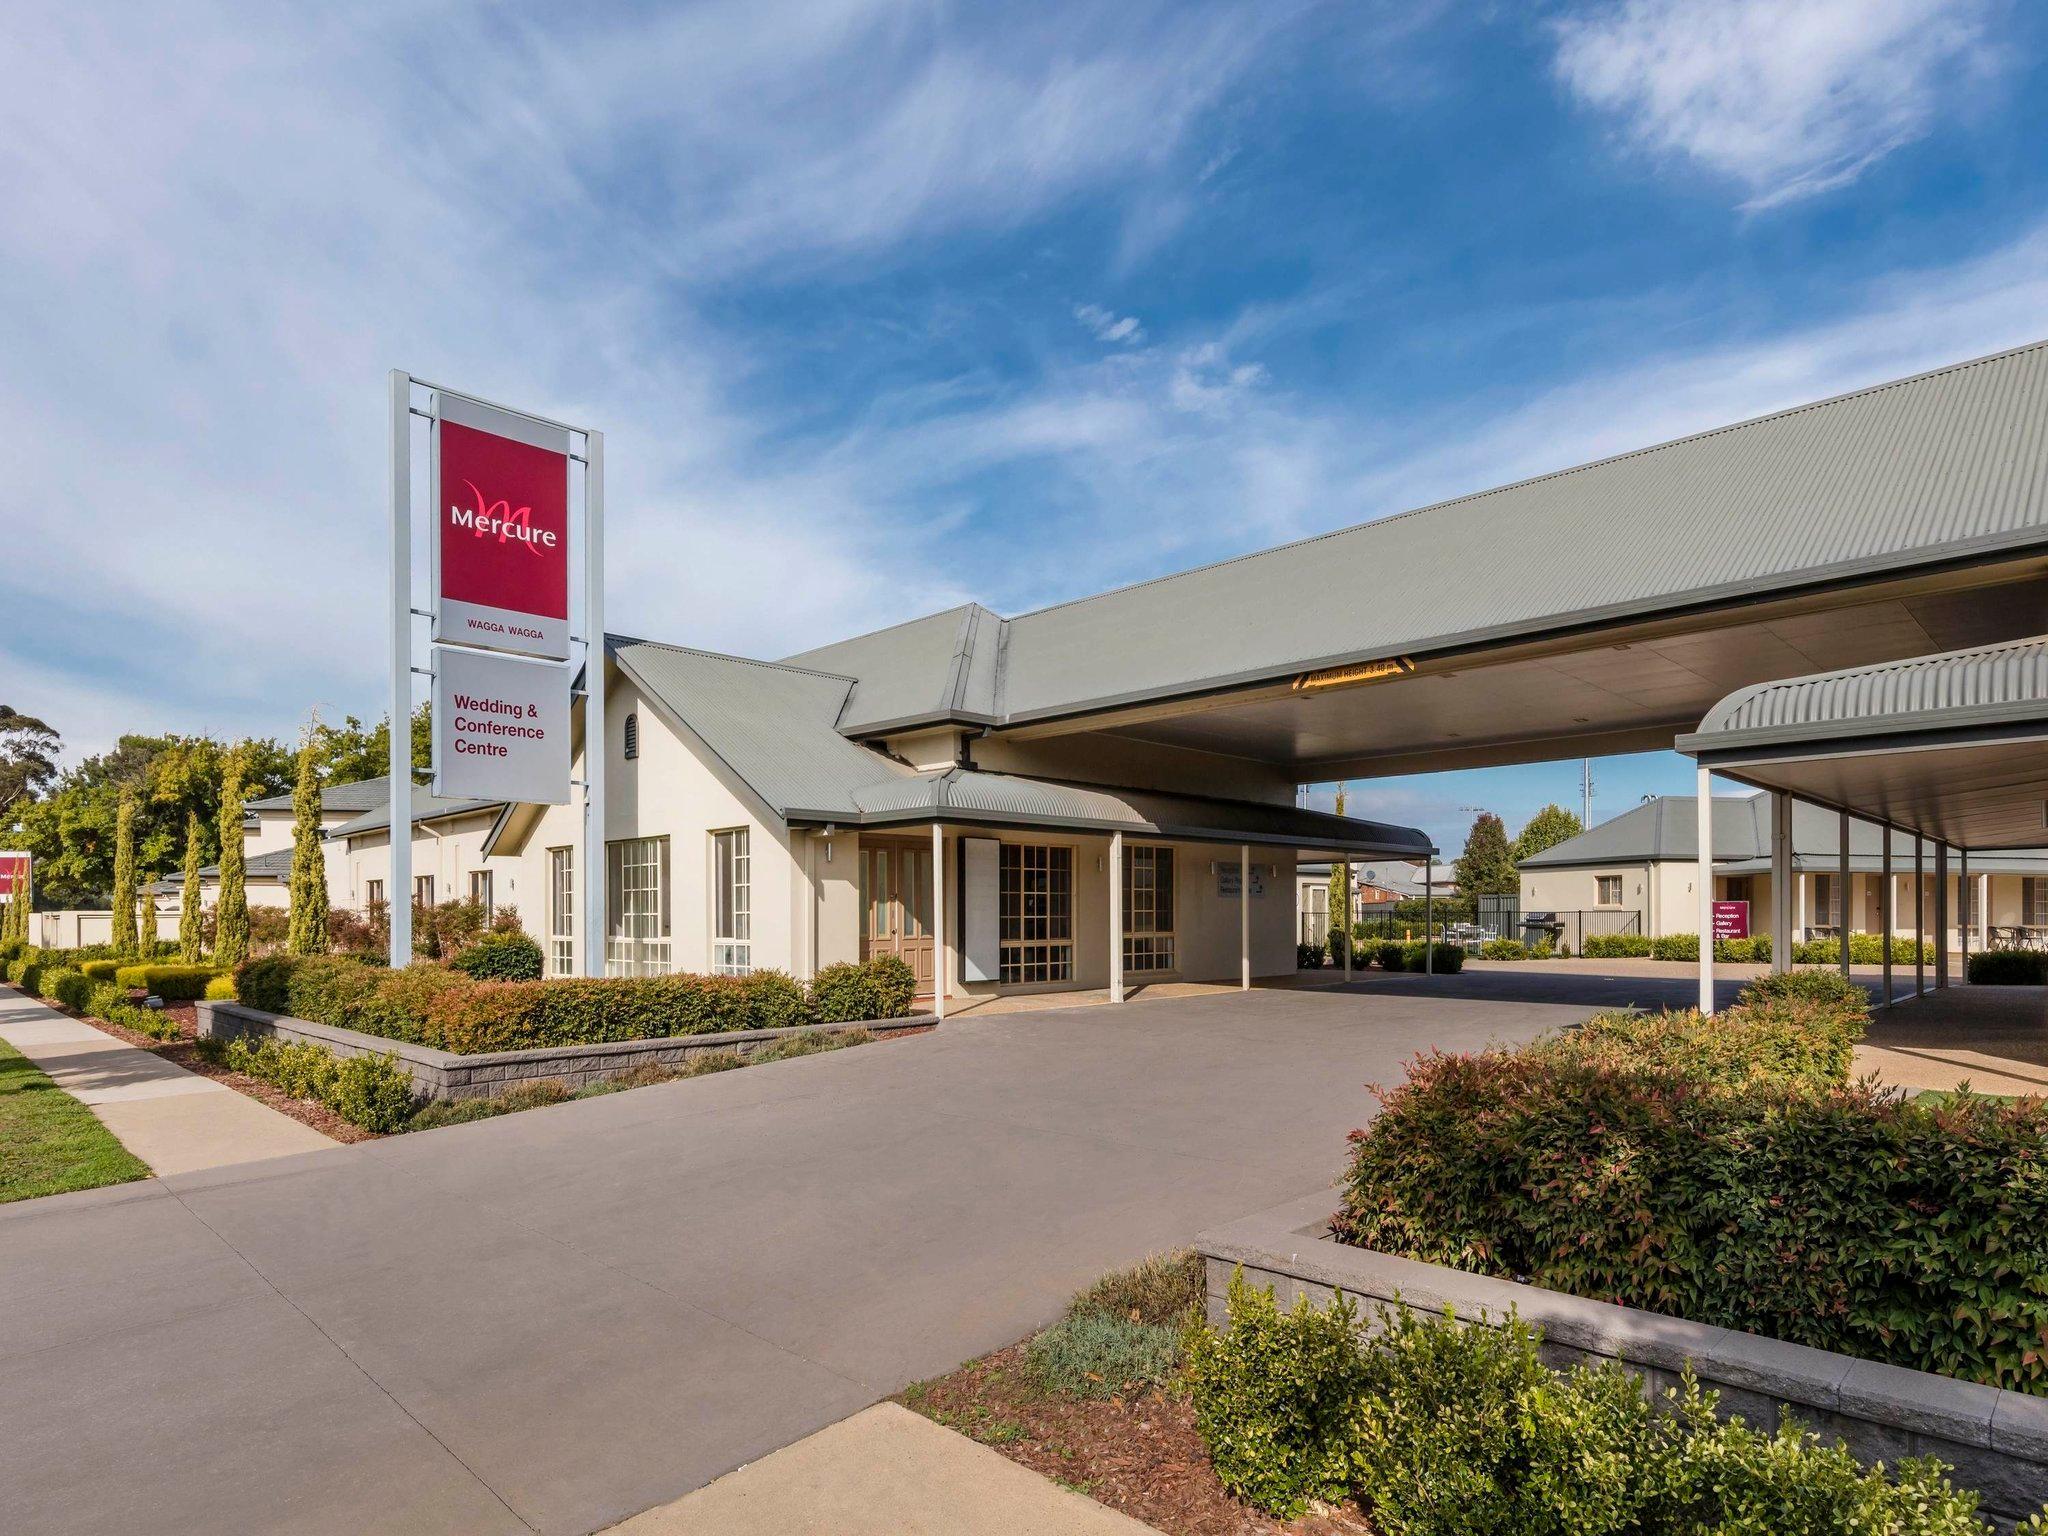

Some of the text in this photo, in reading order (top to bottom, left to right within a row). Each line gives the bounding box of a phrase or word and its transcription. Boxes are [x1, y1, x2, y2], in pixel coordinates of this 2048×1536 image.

[451, 505, 557, 547] Mercure
[467, 618, 544, 640] WAGGA WAGGA
[1310, 671, 1342, 683] MAXIMUM
[1343, 666, 1368, 677] HEIGHT
[454, 694, 538, 719] Wedding &
[454, 716, 545, 739] Conference
[454, 738, 508, 757] Centre
